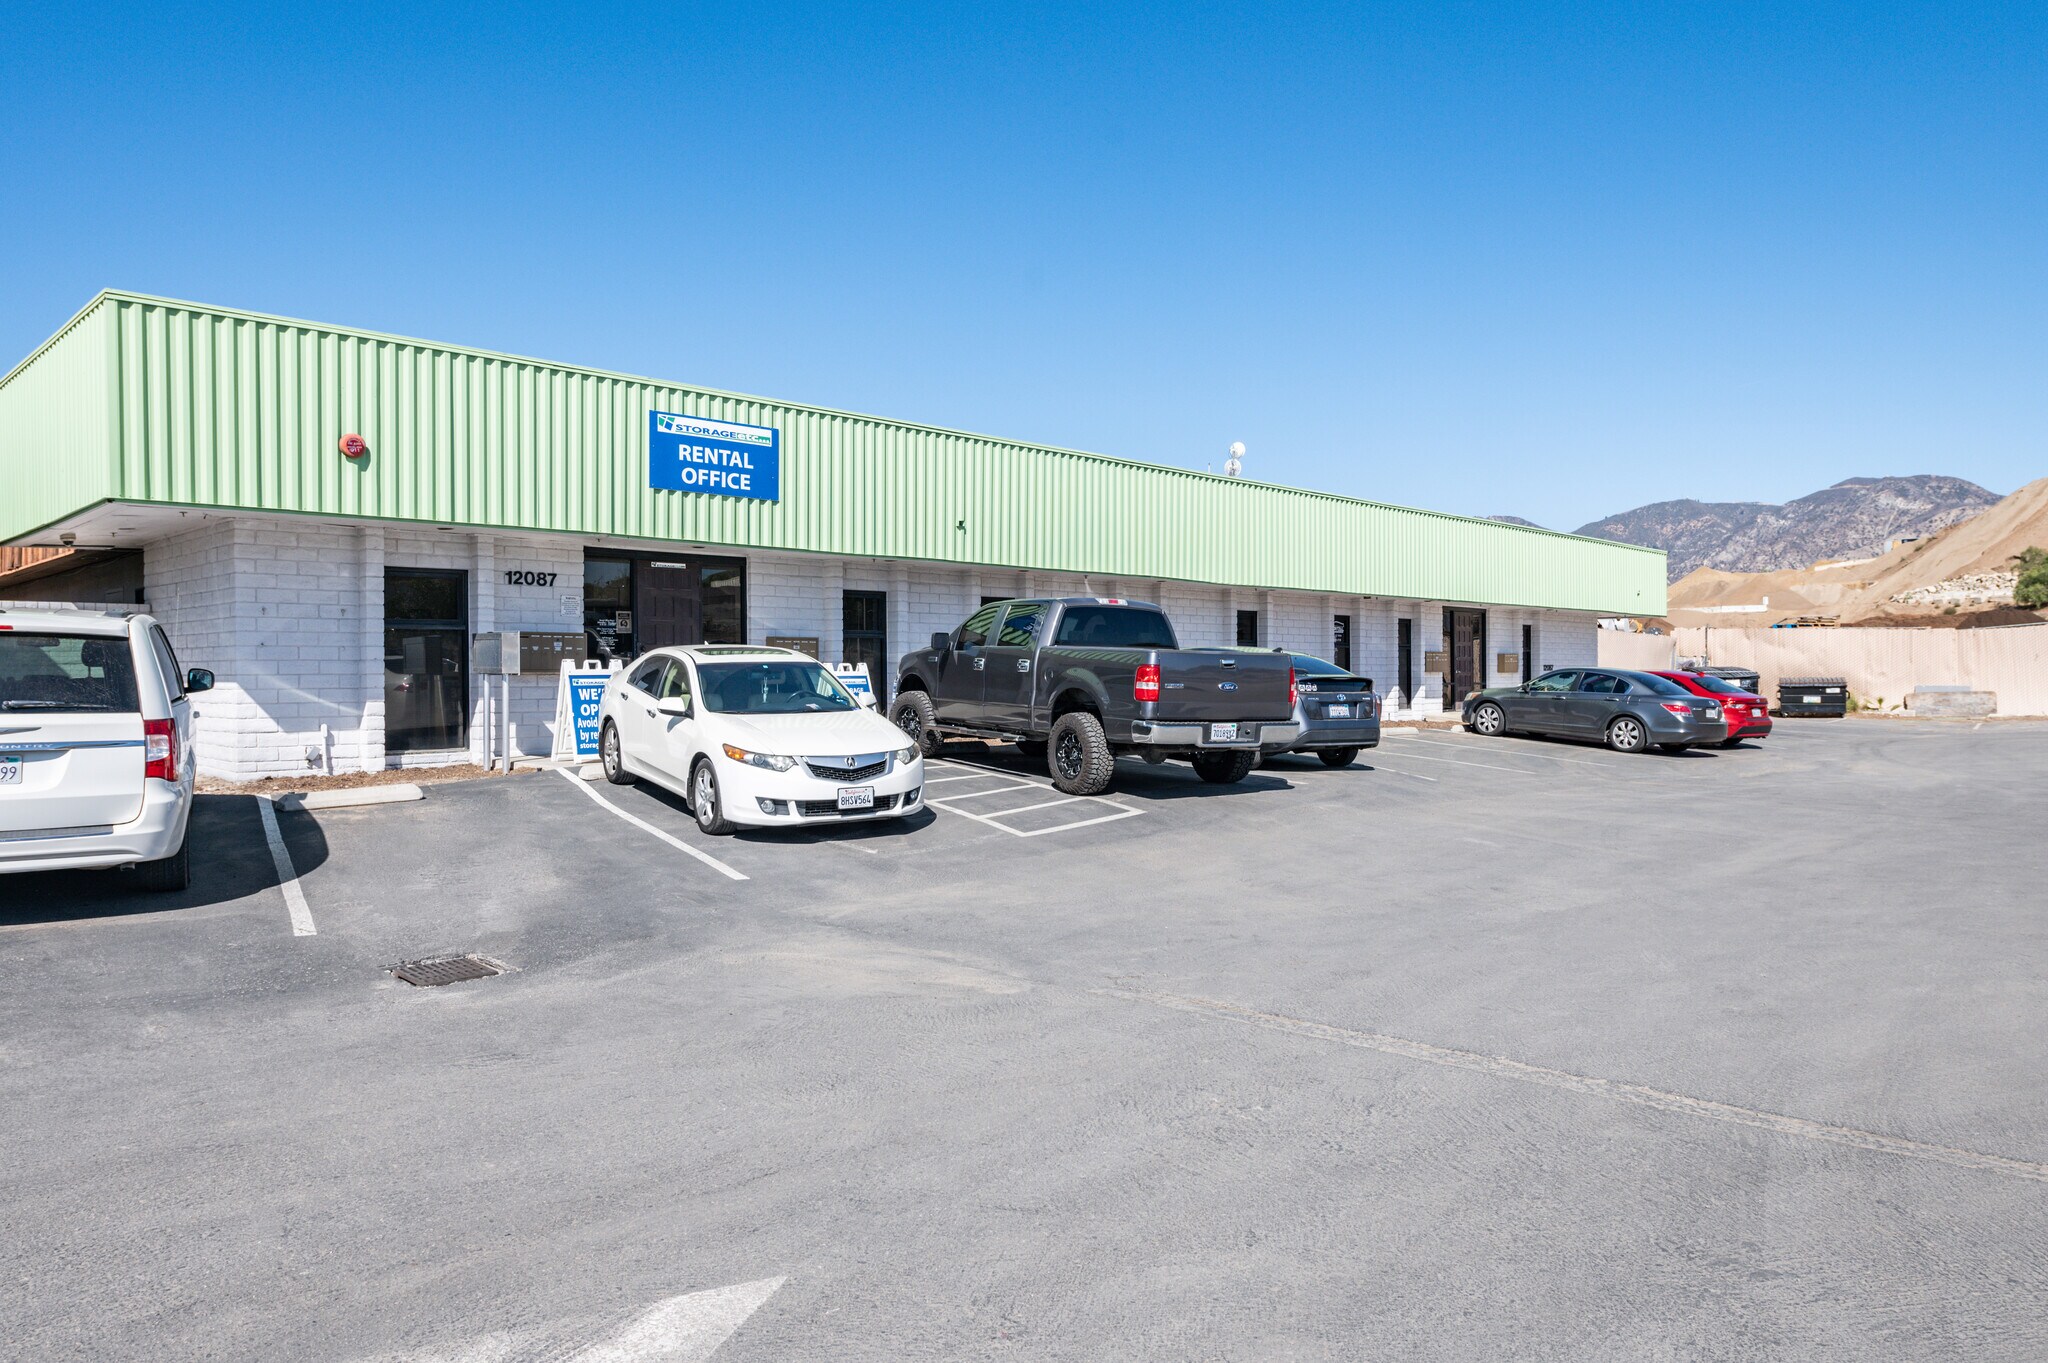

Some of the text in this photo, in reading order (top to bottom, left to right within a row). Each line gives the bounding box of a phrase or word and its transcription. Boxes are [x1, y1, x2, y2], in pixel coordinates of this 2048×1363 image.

[678, 444, 754, 469] RENTAL
[681, 467, 751, 491] OFFICE
[505, 570, 557, 587] 12087
[578, 688, 604, 700] WE'
[580, 703, 600, 716] OP
[577, 717, 598, 728] Avoid
[580, 729, 599, 742] by re
[0, 766, 17, 780] 99
[840, 794, 871, 806] 8HSV564
